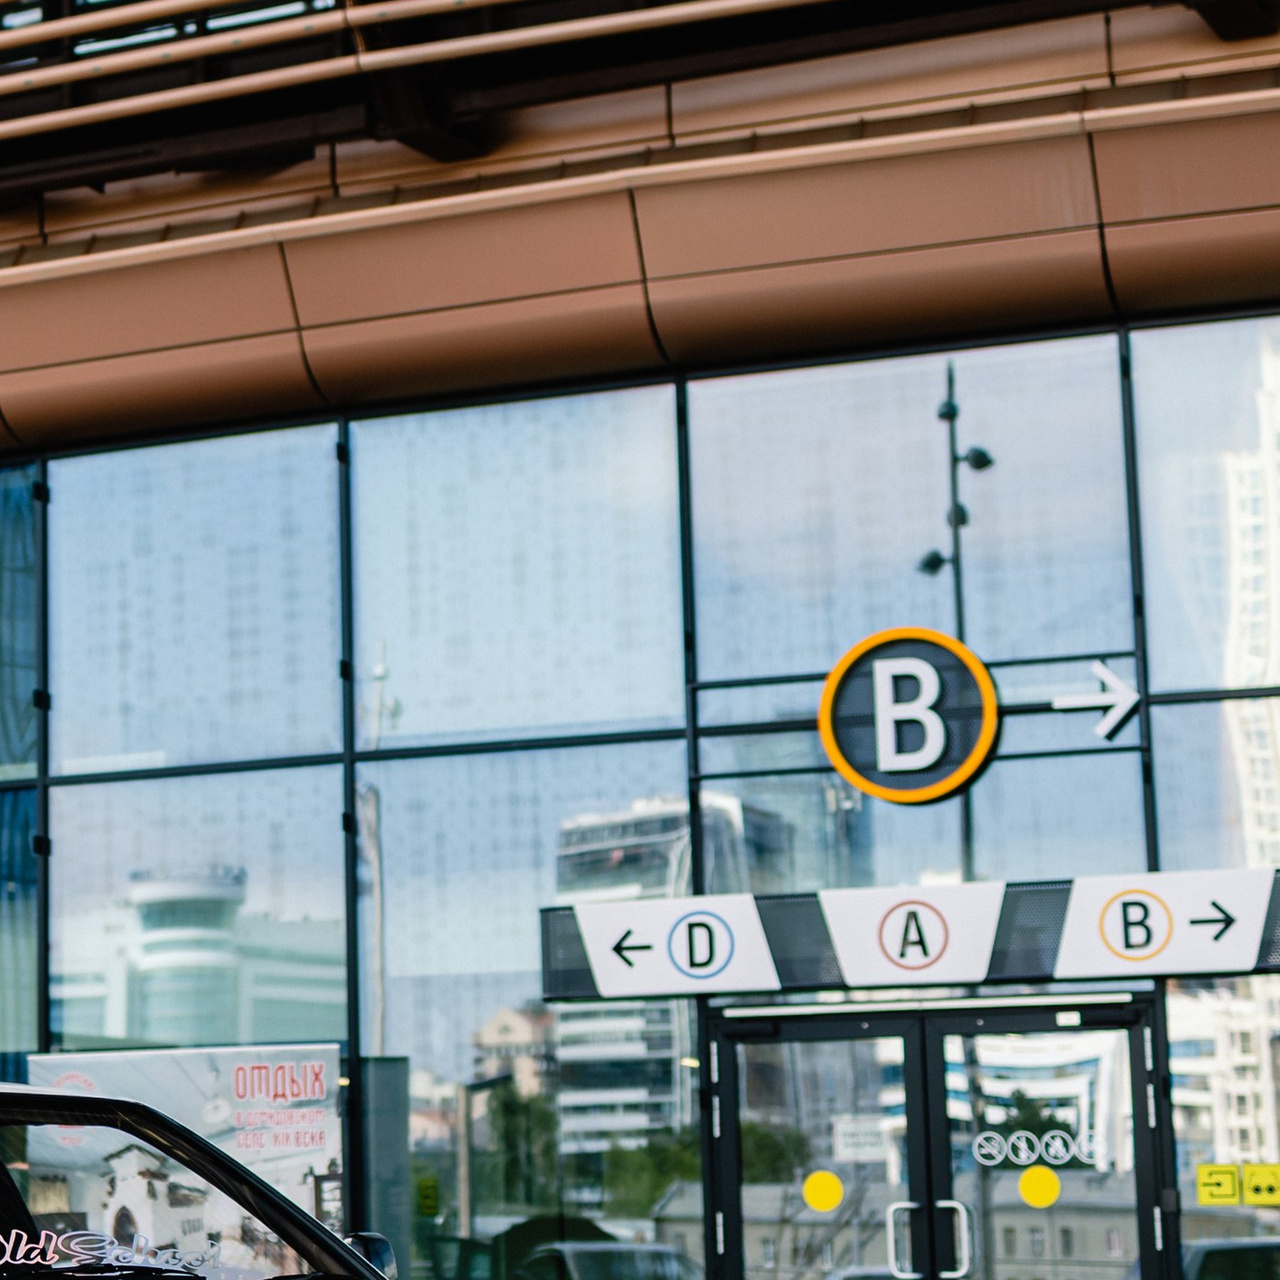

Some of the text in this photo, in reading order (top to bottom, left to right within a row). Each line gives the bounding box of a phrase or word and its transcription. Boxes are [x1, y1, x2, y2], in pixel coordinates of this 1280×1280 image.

[873, 657, 946, 772] B
[688, 922, 715, 968] D
[899, 910, 929, 958] A
[1122, 901, 1152, 949] B
